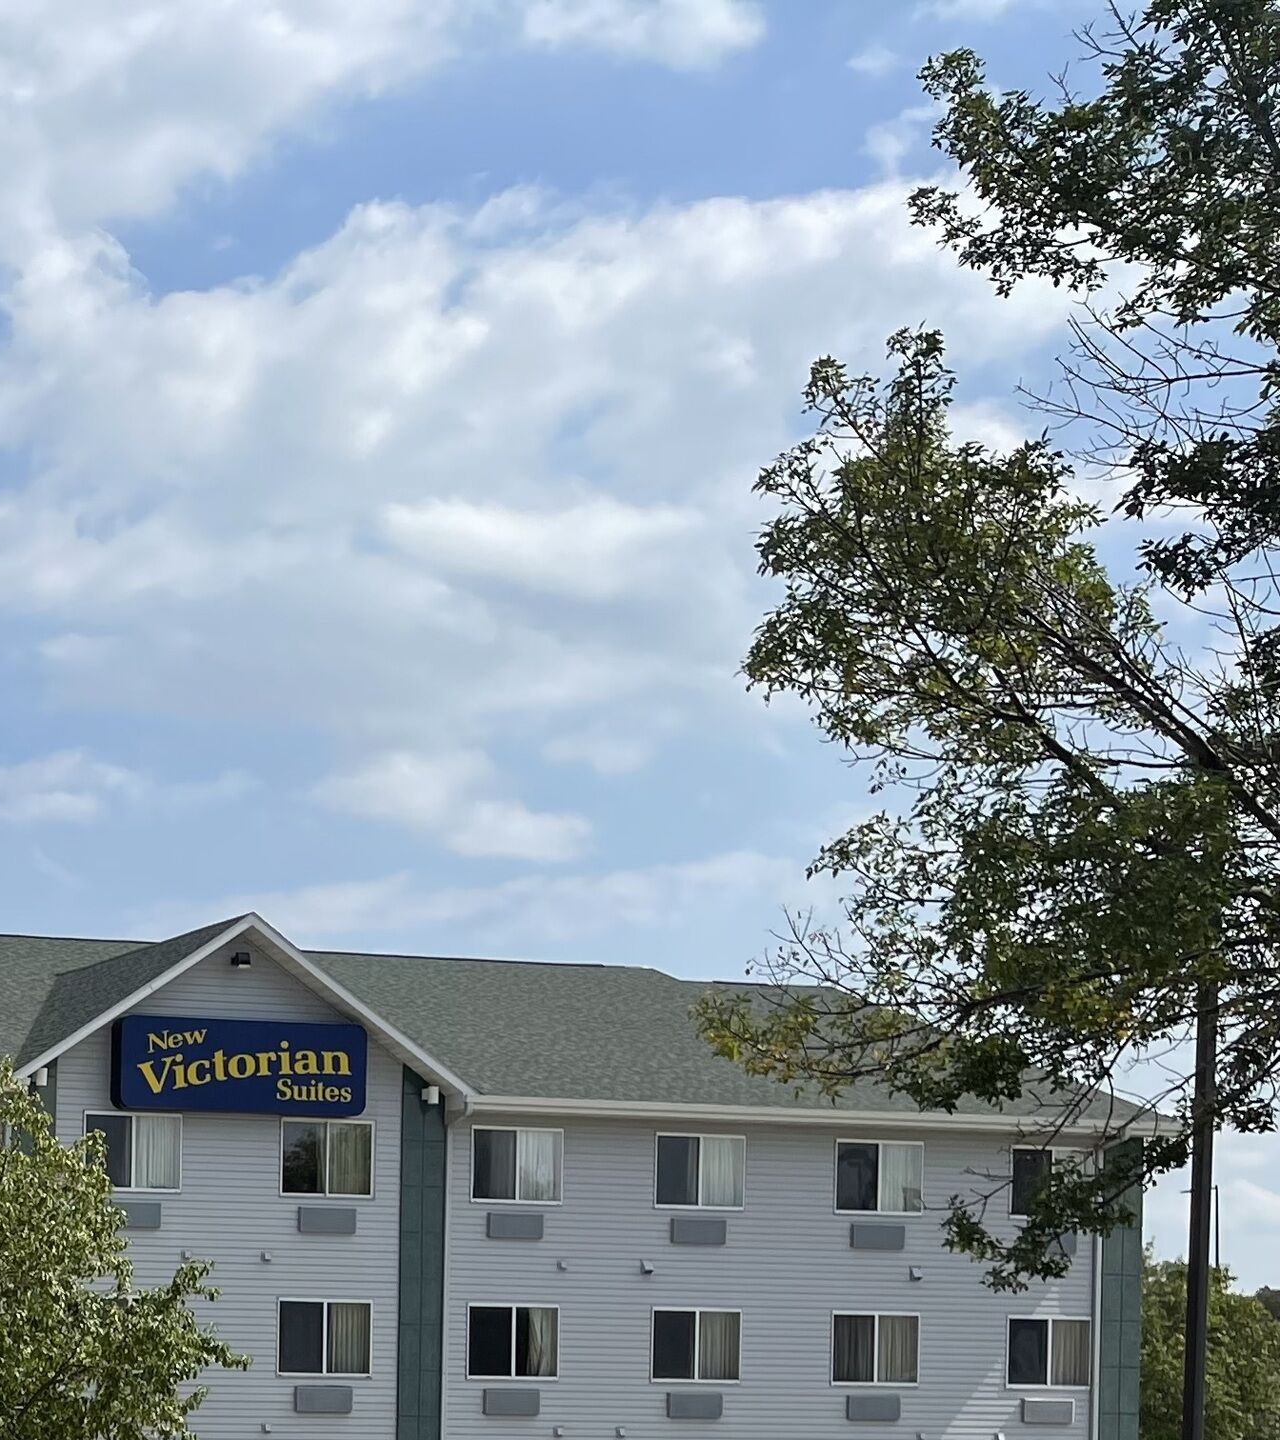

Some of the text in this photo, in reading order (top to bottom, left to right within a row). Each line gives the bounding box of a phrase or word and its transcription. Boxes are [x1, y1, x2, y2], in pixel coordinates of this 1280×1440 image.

[148, 1029, 207, 1053] New
[137, 1041, 352, 1094] Victorian
[276, 1078, 352, 1102] Suites
